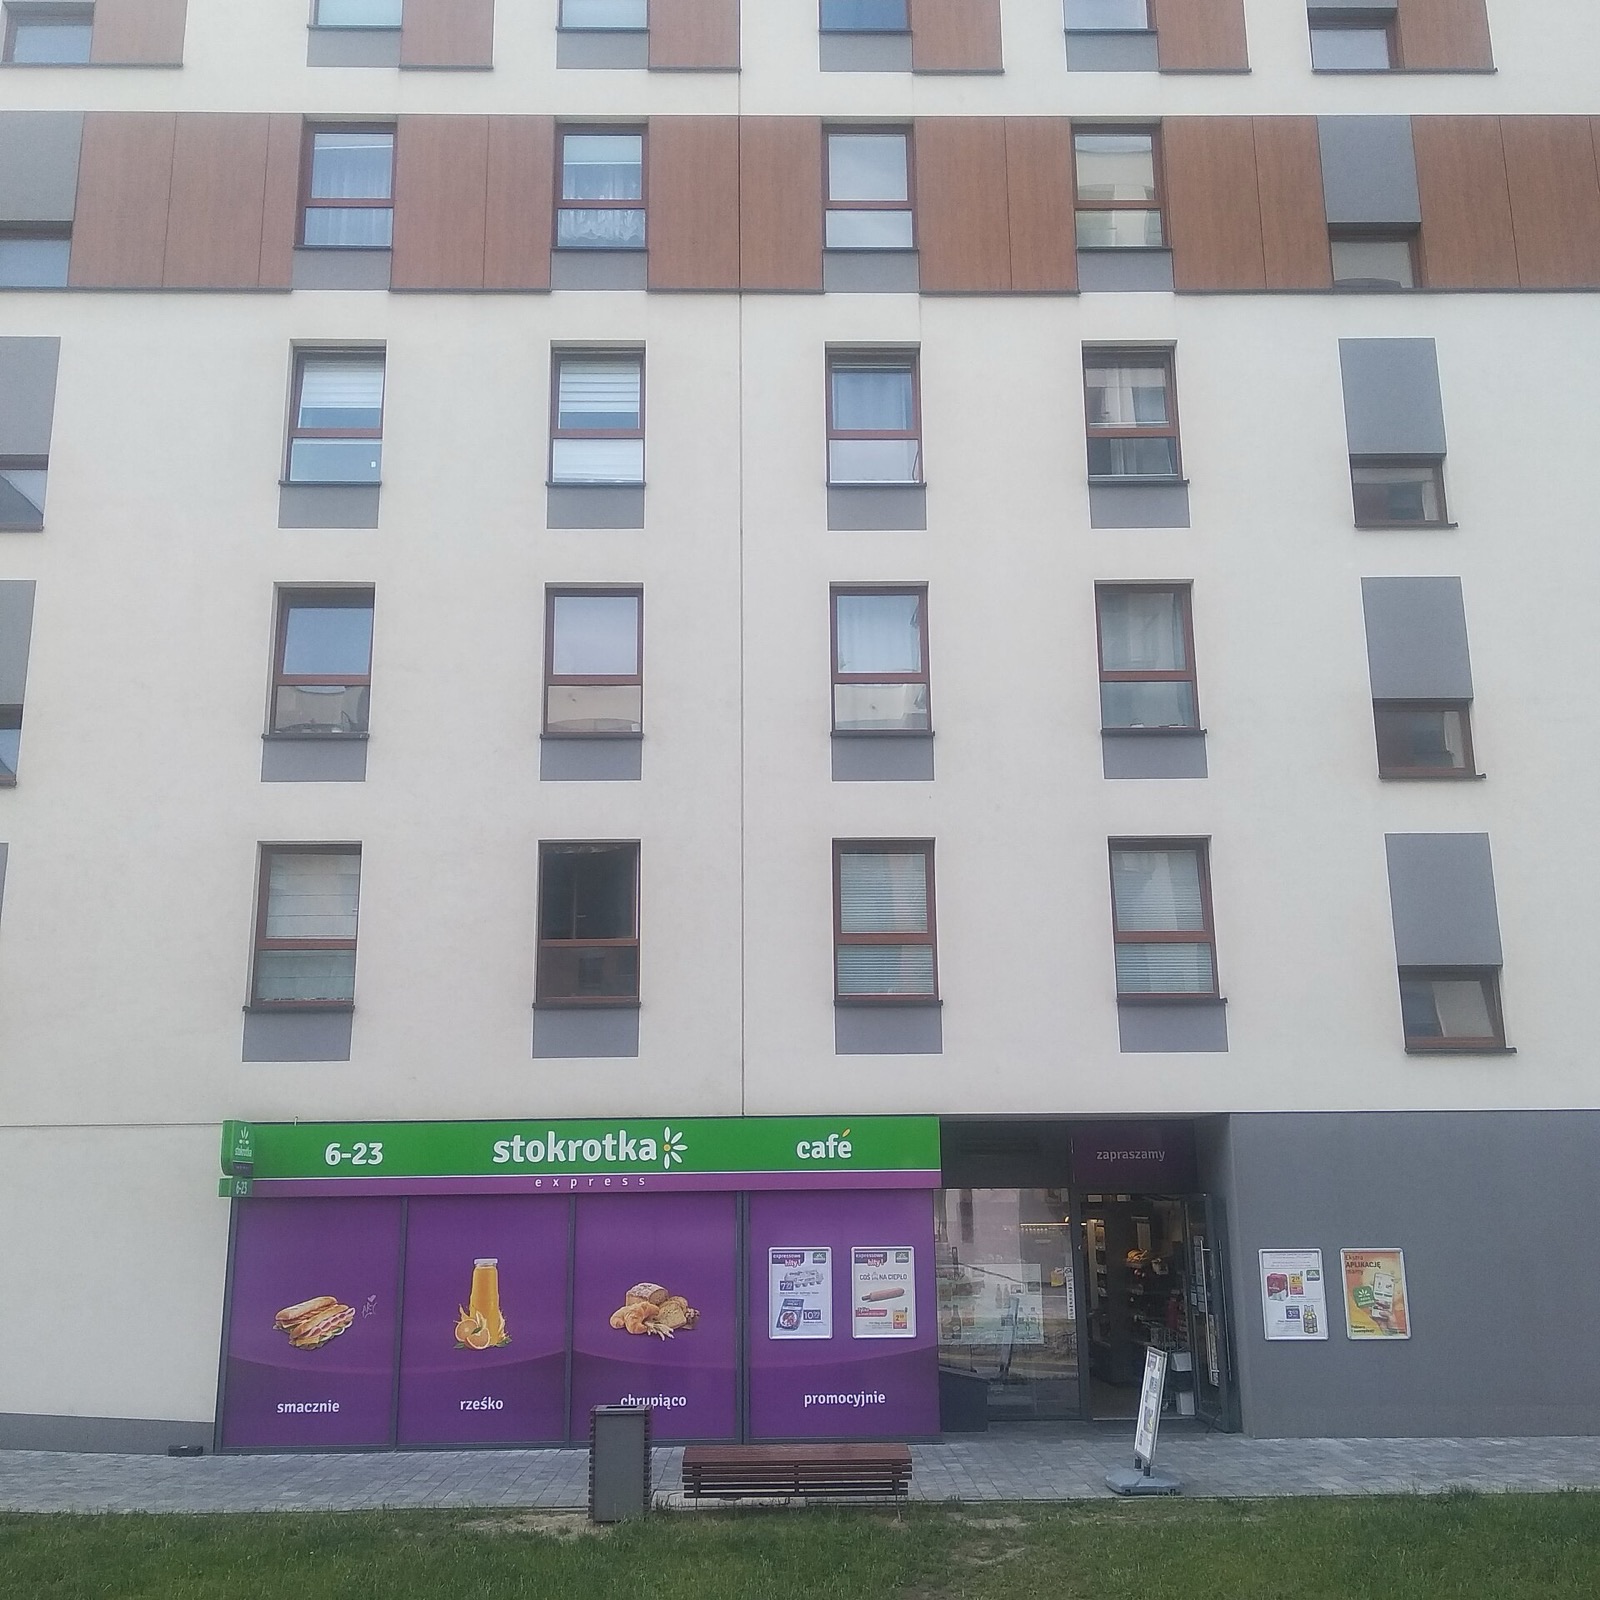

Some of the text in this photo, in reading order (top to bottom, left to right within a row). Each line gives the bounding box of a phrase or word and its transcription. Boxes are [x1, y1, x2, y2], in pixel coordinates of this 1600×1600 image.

[492, 1130, 658, 1163] stokrotka
[796, 1128, 852, 1159] café
[324, 1142, 384, 1166] 6-23
[1096, 1150, 1165, 1162] zapraszamy
[236, 1181, 248, 1195] 6-23
[534, 1177, 646, 1189] express
[276, 1399, 340, 1413] smacznie
[459, 1396, 504, 1411] rześko
[620, 1393, 687, 1410] chrupiąco
[803, 1390, 886, 1407] promocyjnie
